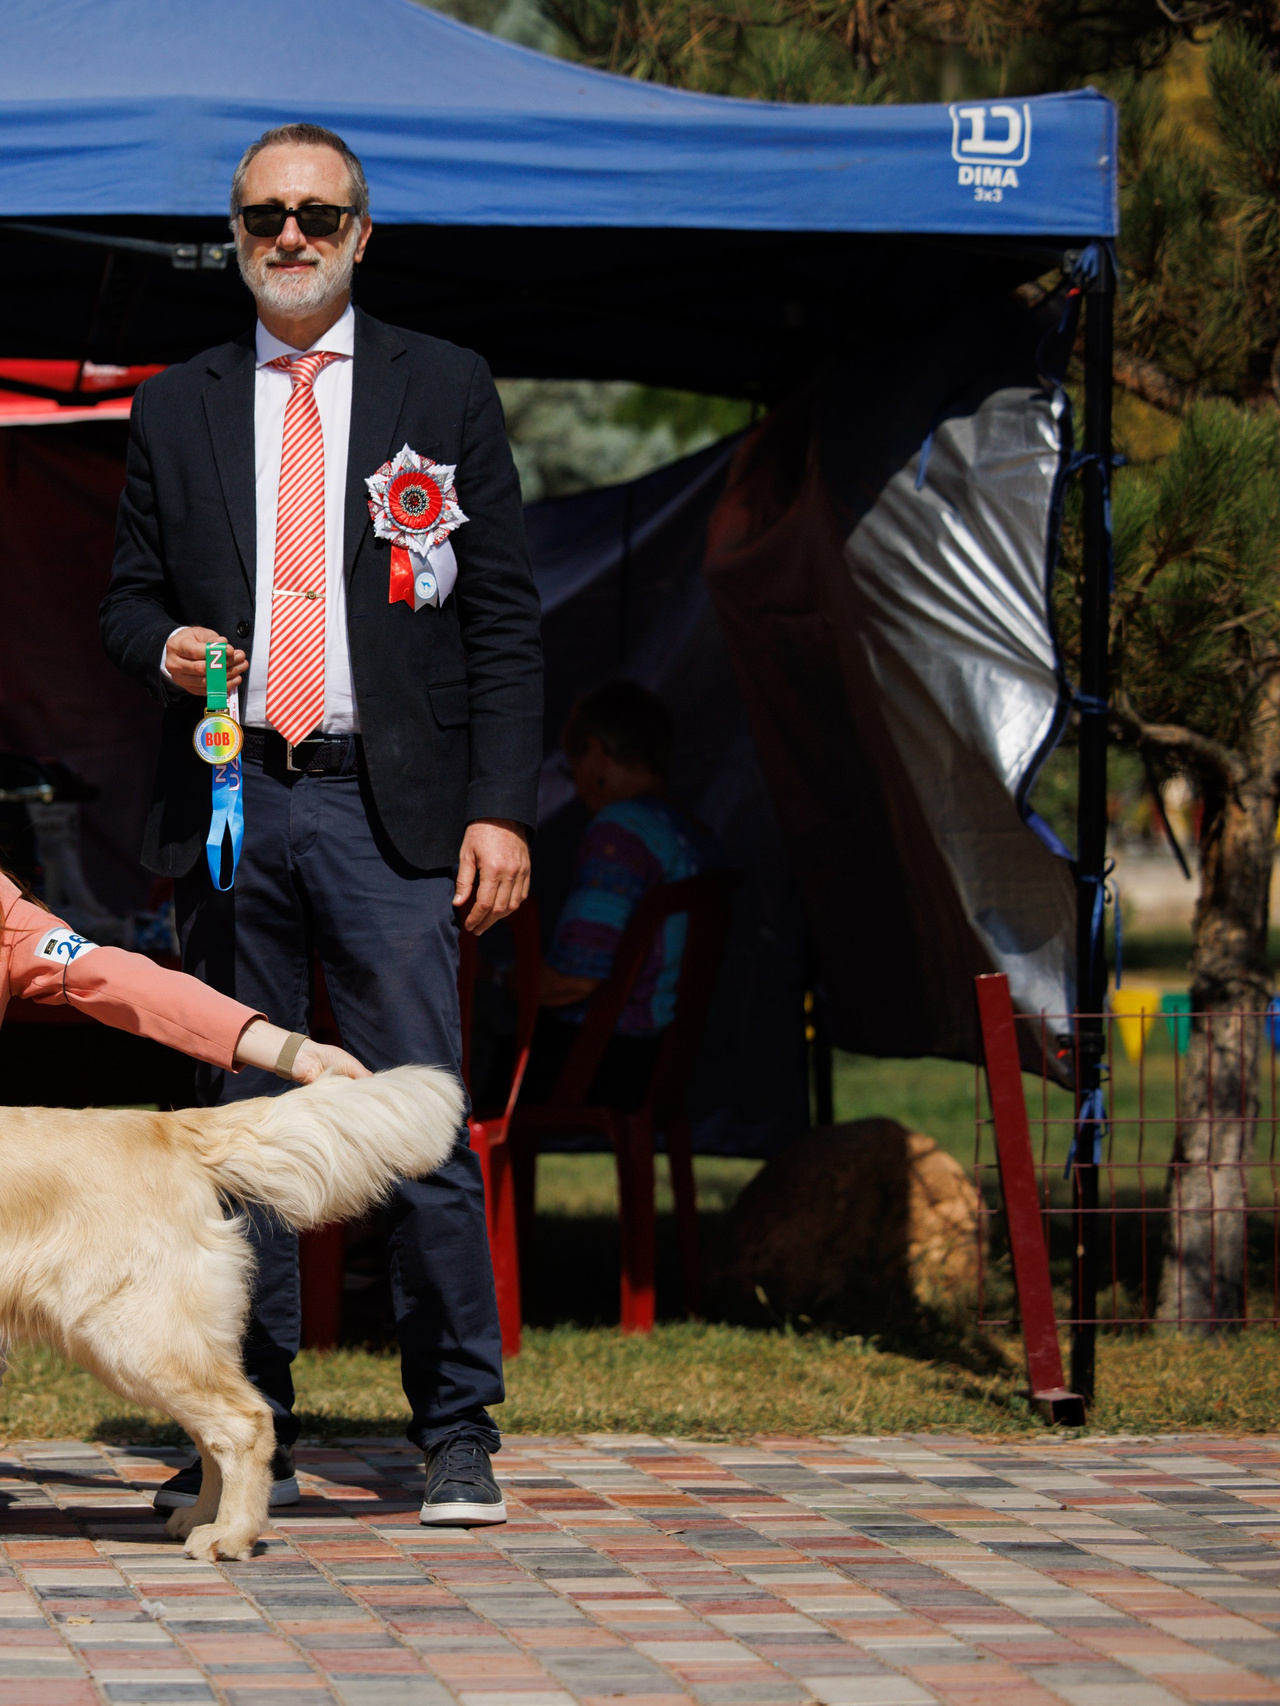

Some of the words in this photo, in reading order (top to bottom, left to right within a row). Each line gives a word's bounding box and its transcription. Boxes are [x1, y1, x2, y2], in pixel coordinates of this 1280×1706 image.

[958, 165, 1019, 188] DIMA
[974, 187, 1003, 202] 3x3
[205, 732, 230, 747] BOB
